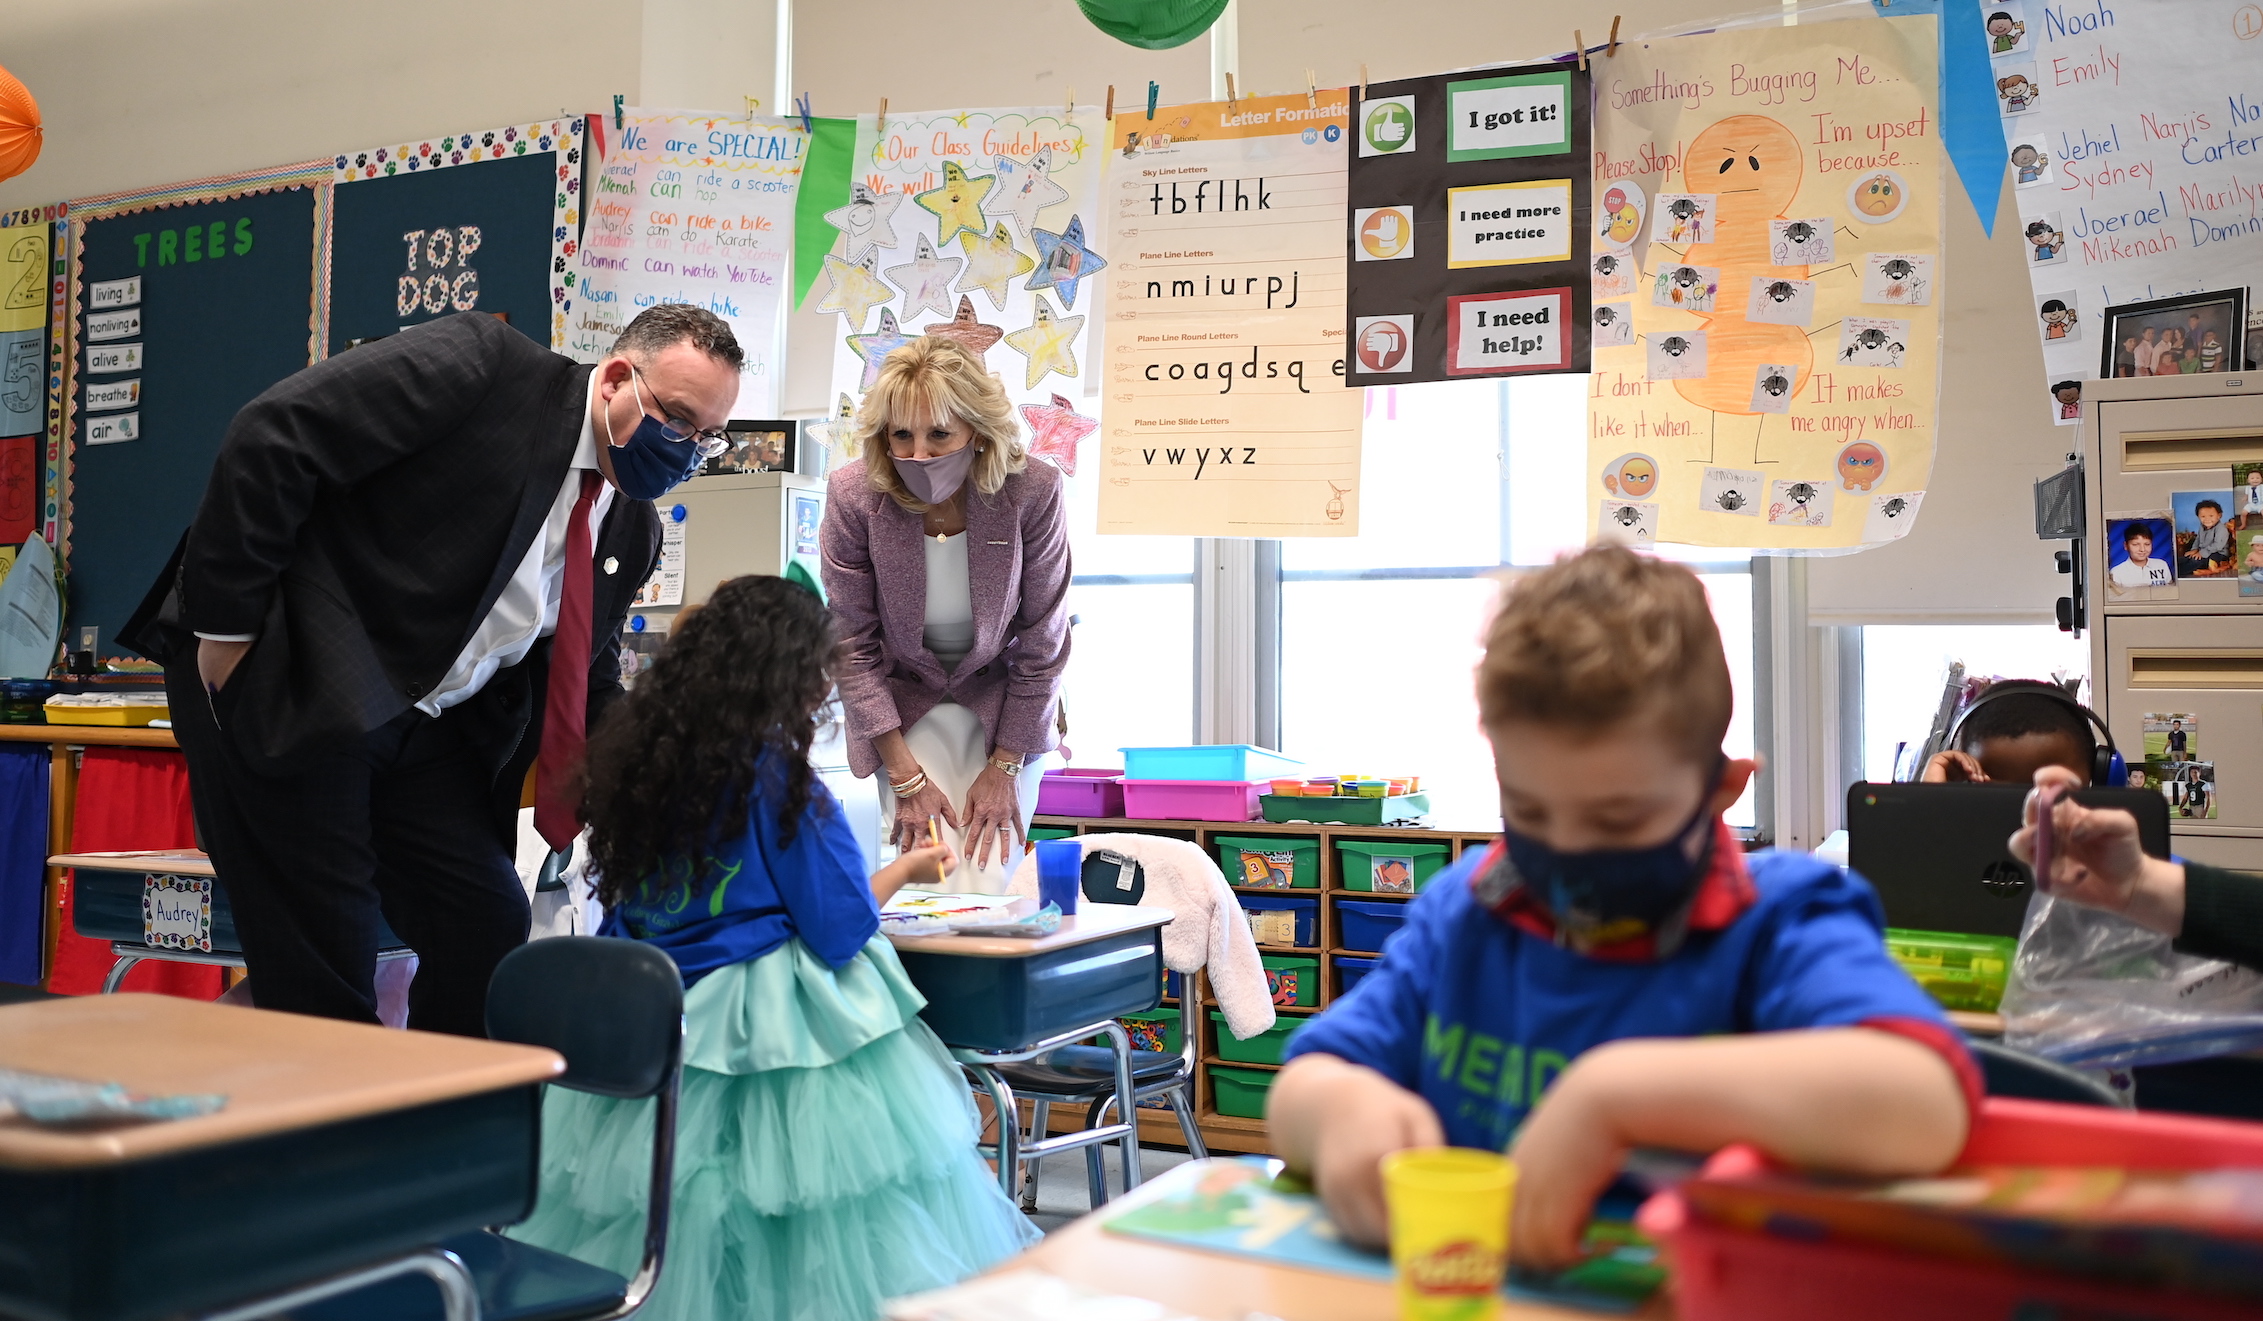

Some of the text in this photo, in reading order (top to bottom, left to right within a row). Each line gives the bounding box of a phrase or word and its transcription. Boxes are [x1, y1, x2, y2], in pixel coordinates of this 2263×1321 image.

[2014, 20, 2025, 33] 4
[2045, 0, 2114, 42] Noah
[2053, 44, 2120, 86] Emily
[1612, 55, 1900, 110] Something's Bugging Me...
[2030, 83, 2039, 96] 5
[1220, 110, 1271, 127] Letter
[1469, 104, 1557, 131] I got it!
[2140, 94, 2263, 147] Narjis Na
[1303, 128, 1337, 141] PK K
[1811, 106, 1930, 151] I'm upset
[621, 127, 801, 161] We are SPECIAL!
[888, 129, 1071, 162] Our Class Guidelines
[2058, 124, 2120, 160] Jehiel
[1595, 140, 1682, 182] Please Stop!
[2038, 153, 2048, 164] 6
[657, 169, 682, 182] can
[697, 170, 722, 187] ride
[732, 179, 740, 190] a
[1179, 166, 1208, 174] Letters
[2061, 160, 2154, 200] Sydney
[650, 182, 682, 199] can
[866, 174, 894, 196] We
[902, 172, 934, 196] will
[1608, 196, 1622, 205] STOP
[11, 211, 20, 226] 7
[21, 209, 29, 225] 8
[31, 207, 40, 223] 9
[43, 205, 56, 221] 10
[592, 198, 633, 226] Audrey
[650, 211, 678, 226] can
[687, 214, 717, 229] ride
[722, 219, 732, 231] a
[1460, 206, 1561, 222] I need more
[2073, 191, 2168, 238] Joerael
[133, 217, 253, 267] TREES
[647, 226, 669, 236] can
[681, 226, 697, 241] do
[1475, 228, 1546, 244] practice
[403, 226, 482, 271] TOP
[1140, 252, 1163, 260] Plane
[1183, 250, 1214, 258] Letters
[2083, 228, 2177, 265] Mikenah
[5, 236, 45, 309] 2
[582, 250, 629, 271] Dominic
[645, 258, 674, 275] can
[682, 263, 718, 279] watch
[96, 287, 122, 303] living
[397, 271, 479, 317] DOG
[580, 276, 618, 303] Nasani
[634, 292, 655, 306] can
[596, 304, 624, 322] Emily
[1477, 307, 1550, 327] I need
[90, 317, 129, 334] nonliving
[1137, 334, 1160, 342] Plane
[1209, 332, 1239, 340] Letters
[1482, 335, 1543, 355] help!
[92, 353, 118, 367] alive
[1, 338, 41, 413] 5
[1591, 372, 1655, 398] I don't
[88, 388, 127, 402] breathe
[1811, 373, 1903, 403] It makes
[92, 422, 112, 438] air
[1159, 418, 1176, 426] Line
[1178, 417, 1199, 426] Slide
[1200, 417, 1229, 425] Letters
[1593, 411, 1625, 438] like
[1634, 410, 1646, 438] it
[1791, 416, 1816, 432] me
[1822, 413, 1866, 443] angry
[2149, 569, 2165, 579] NY
[2190, 790, 2196, 801] 9
[1250, 863, 1259, 873] 3
[157, 901, 199, 932] Audrey
[1282, 924, 1290, 936] 3
